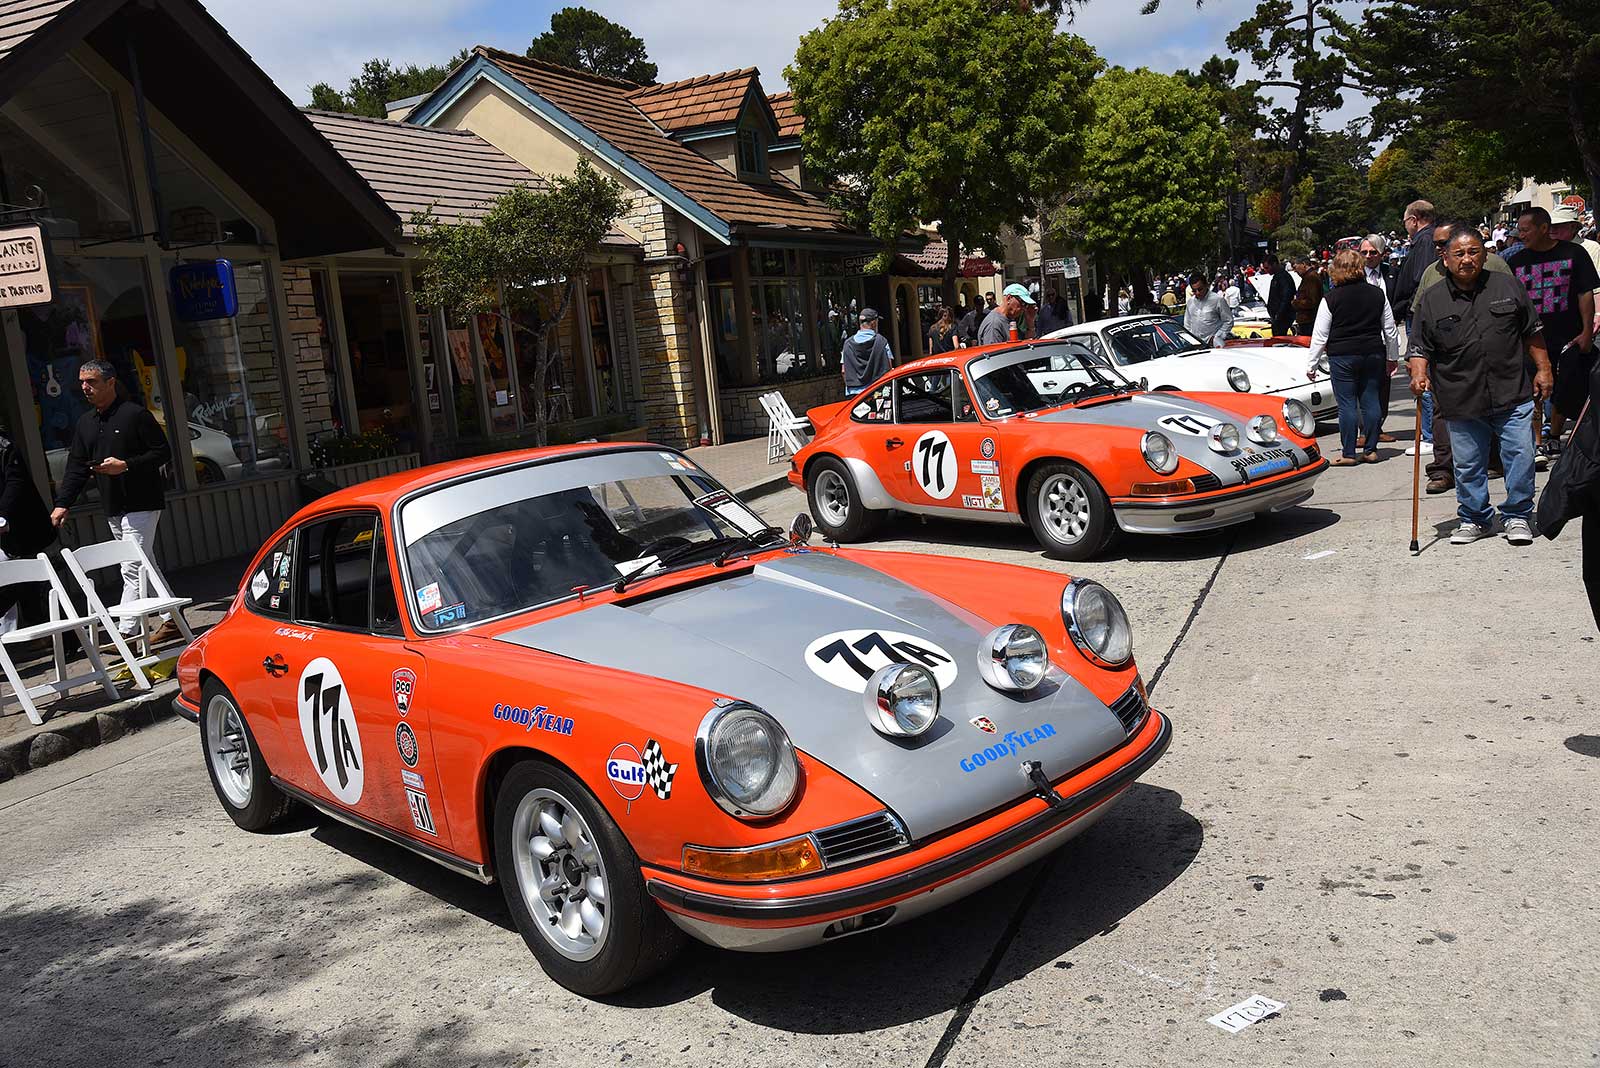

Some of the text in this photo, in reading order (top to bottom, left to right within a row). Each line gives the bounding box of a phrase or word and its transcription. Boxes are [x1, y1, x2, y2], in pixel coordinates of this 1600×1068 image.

[0, 241, 34, 258] ANTE
[8, 284, 44, 297] TASTING
[1162, 415, 1212, 434] 77
[919, 436, 948, 492] 77
[1231, 453, 1268, 471] QUAKER
[814, 631, 952, 681] 77A
[304, 672, 361, 790] 77A
[493, 703, 575, 736] GOODYEAR
[959, 723, 1057, 773] GOODYEAR
[608, 761, 645, 783] Gulf
